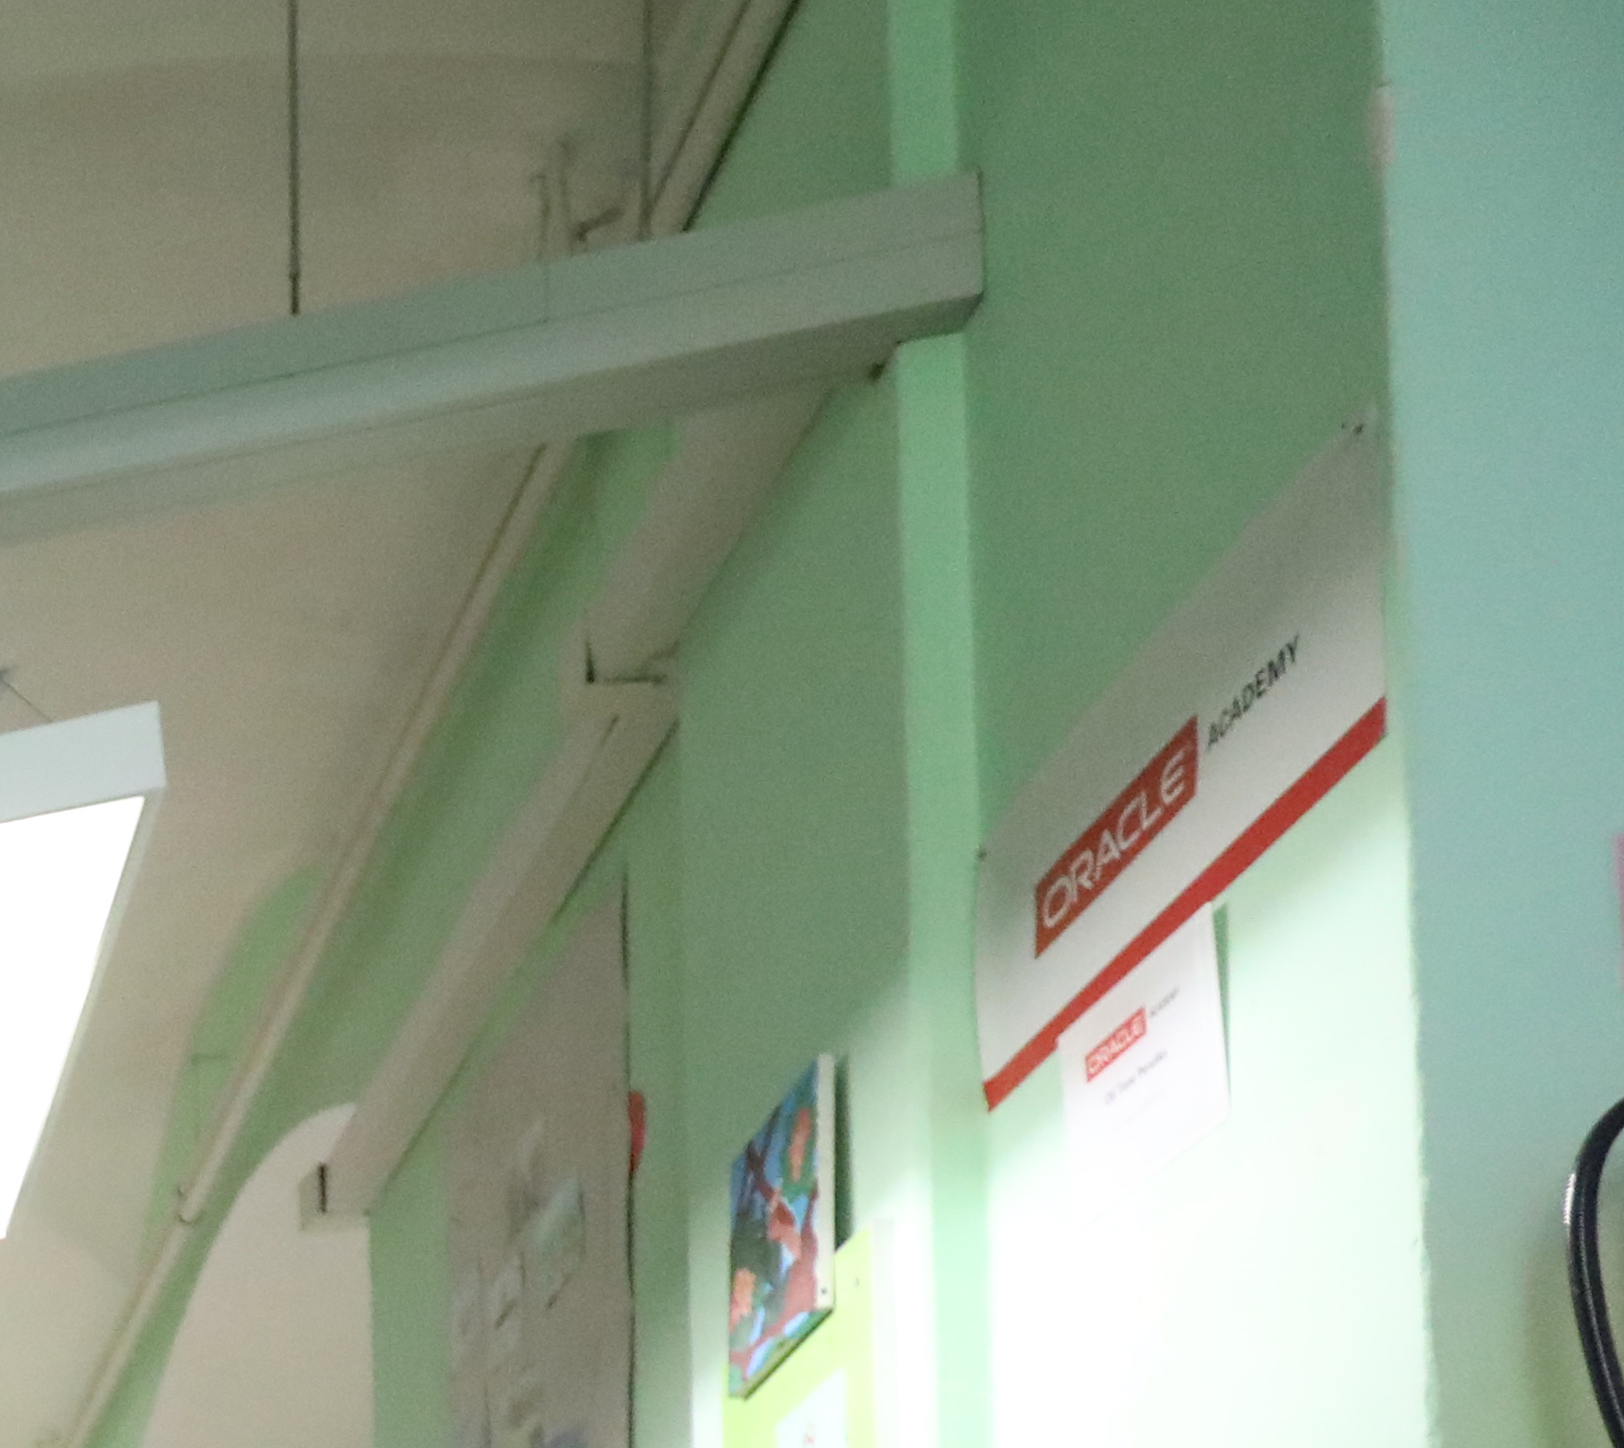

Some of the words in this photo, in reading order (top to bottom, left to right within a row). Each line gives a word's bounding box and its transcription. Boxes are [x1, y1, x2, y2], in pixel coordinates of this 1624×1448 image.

[1041, 748, 1186, 929] ORACLE
[1208, 634, 1299, 753] ACADEMY
[1087, 1011, 1145, 1077] ORACLE
